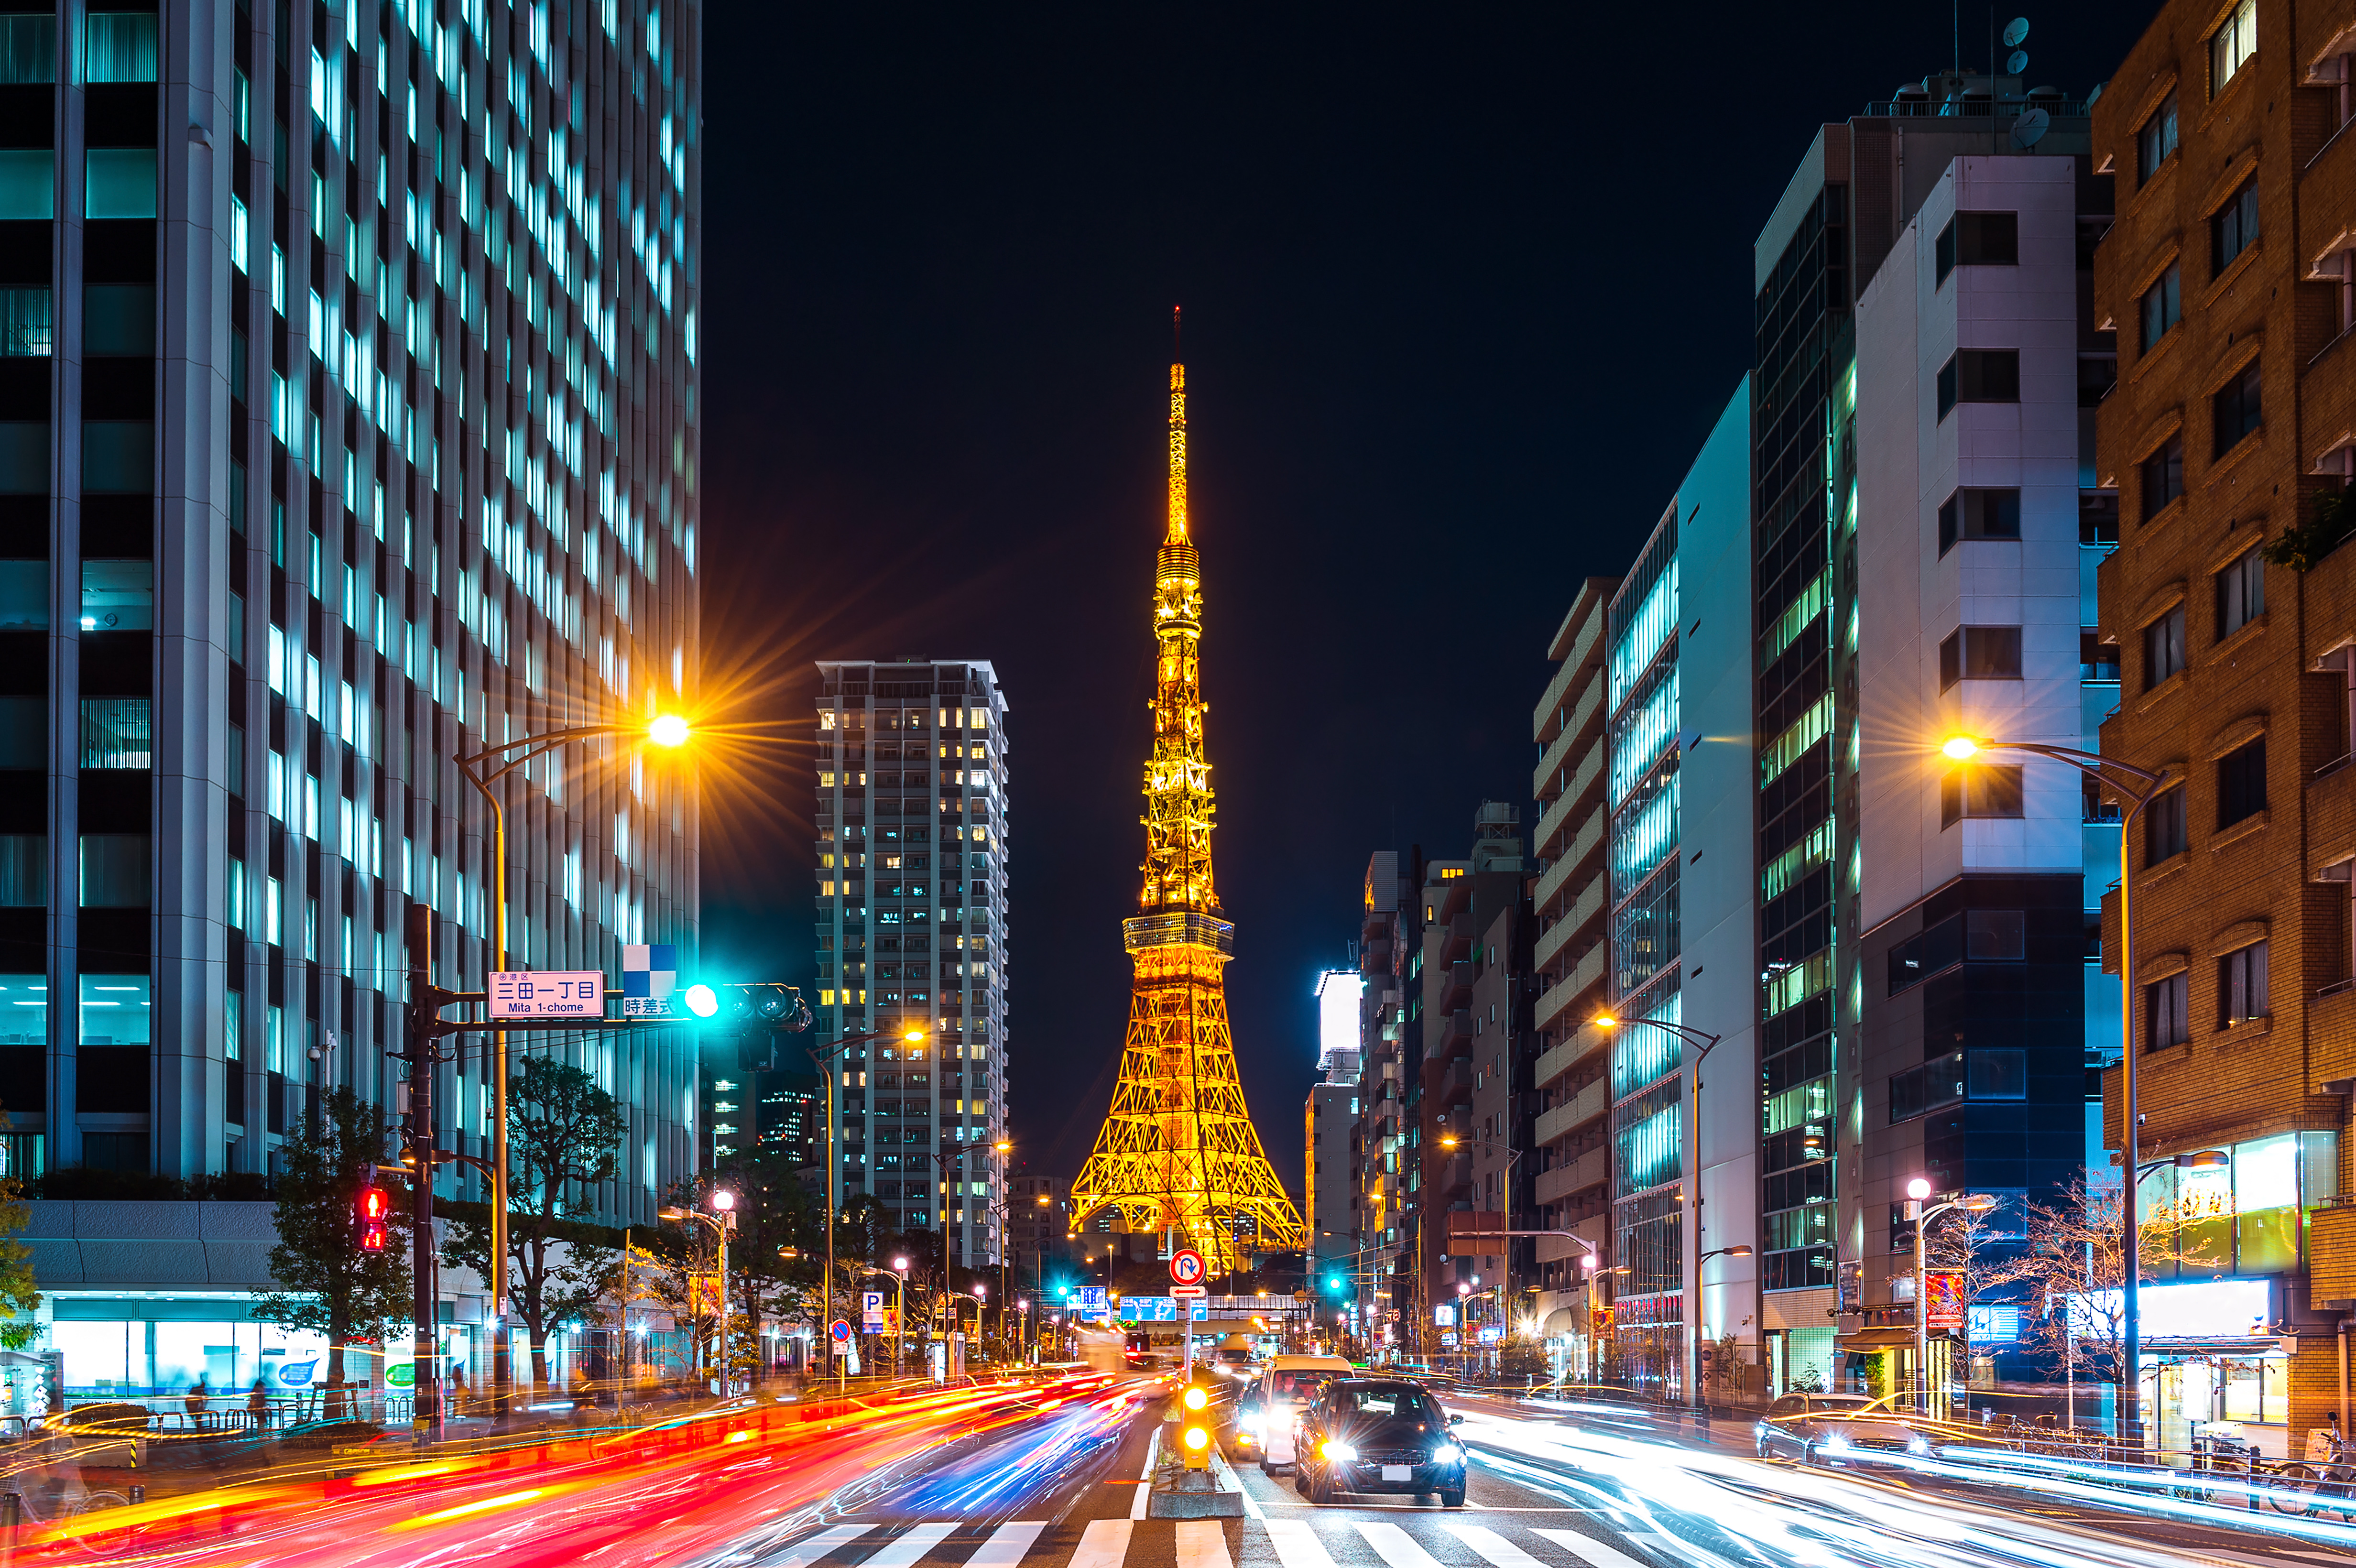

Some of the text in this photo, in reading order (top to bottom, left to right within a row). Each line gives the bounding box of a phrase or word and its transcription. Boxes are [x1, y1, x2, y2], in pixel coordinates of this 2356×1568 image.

[498, 981, 593, 999] 三田一丁目
[508, 1002, 583, 1012] Mita 1-chome
[625, 998, 675, 1013] 時差式
[868, 1295, 879, 1310] P
